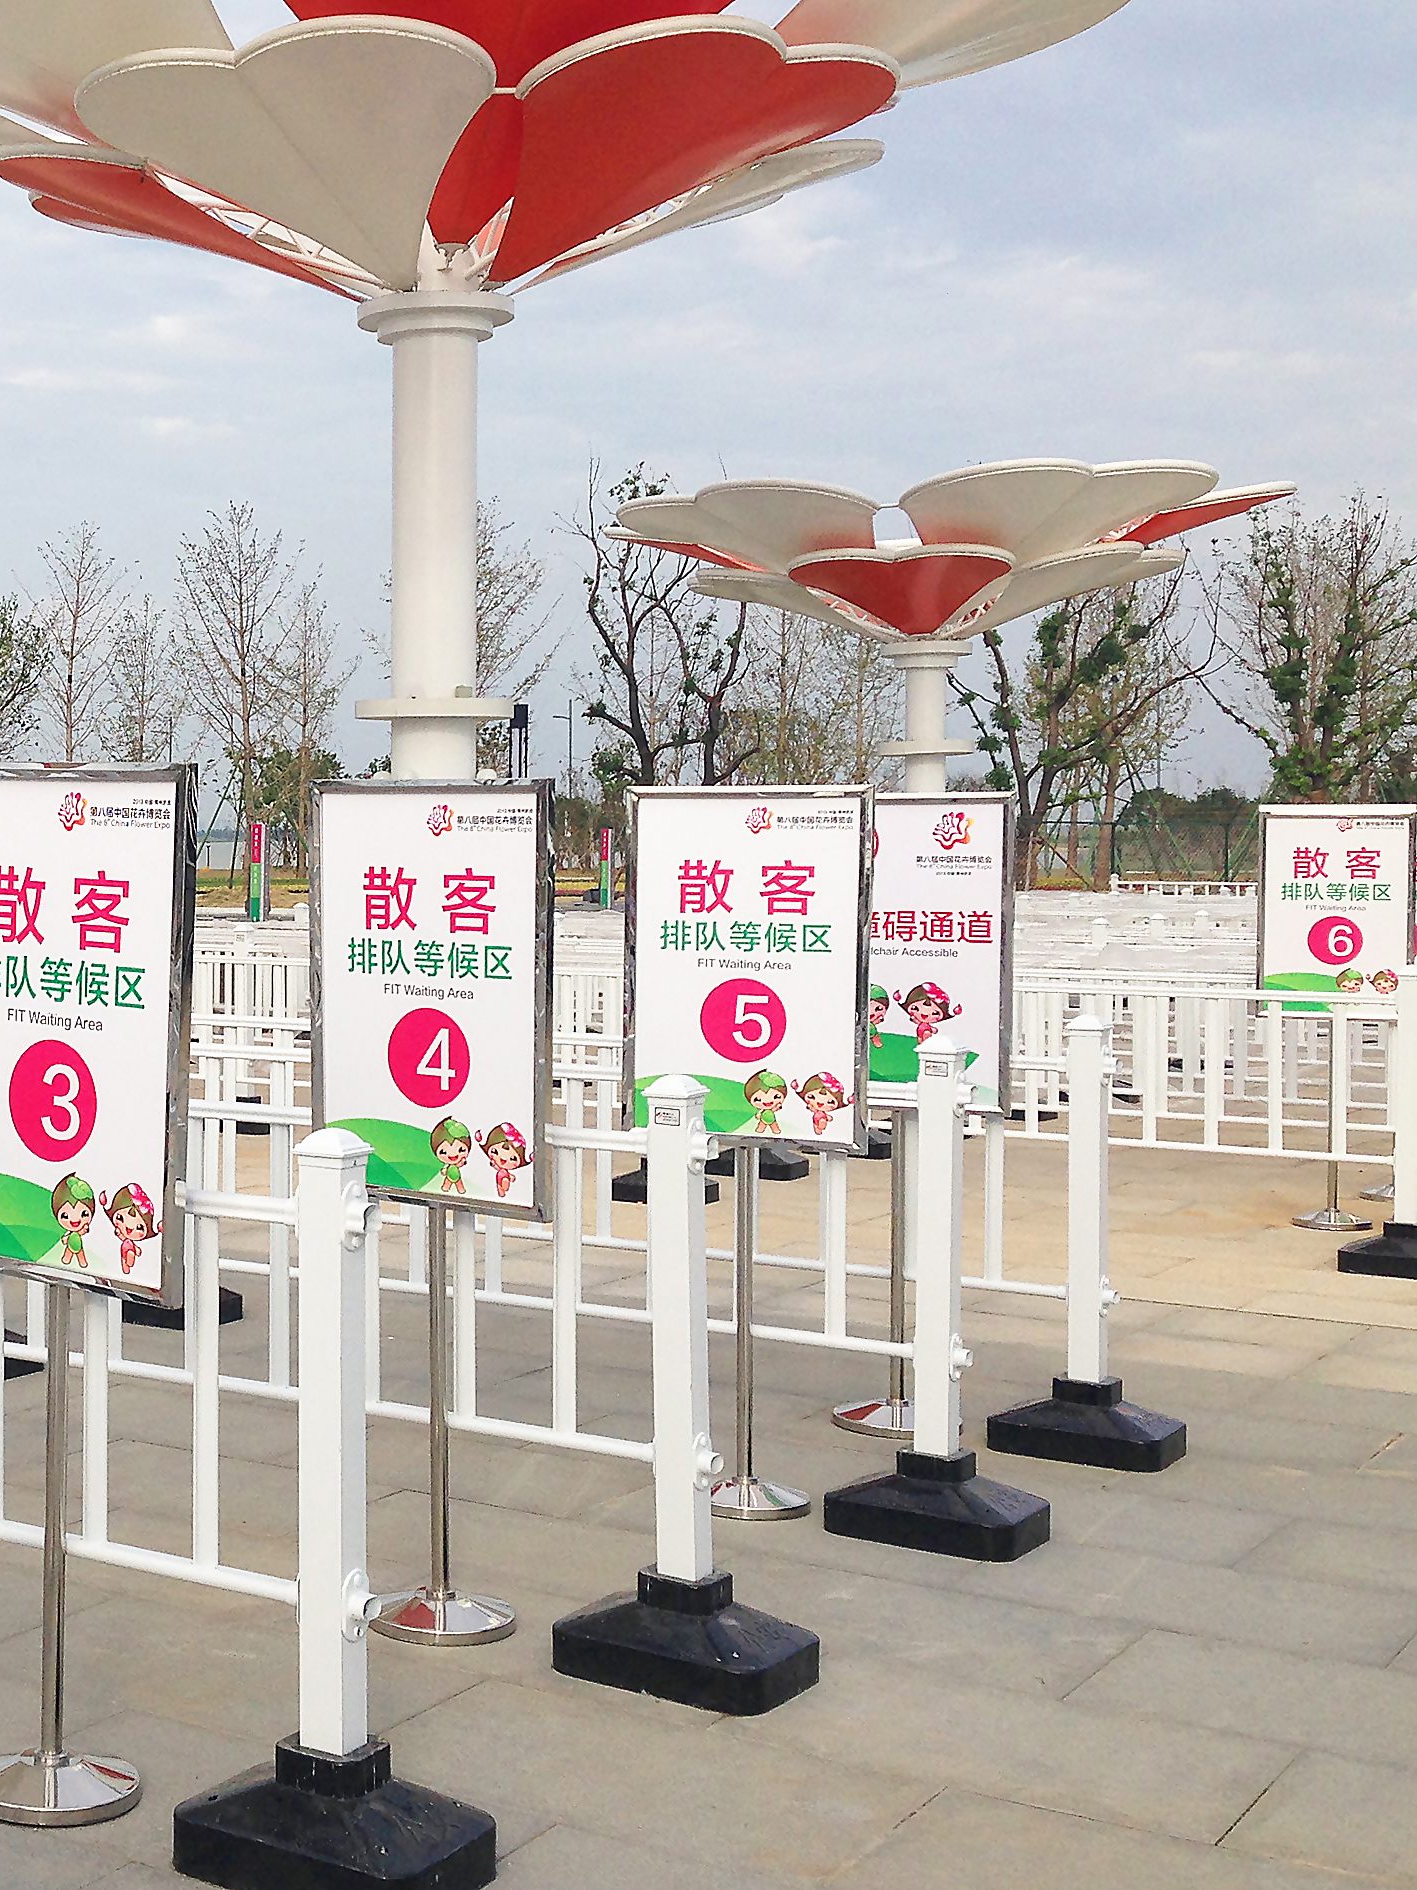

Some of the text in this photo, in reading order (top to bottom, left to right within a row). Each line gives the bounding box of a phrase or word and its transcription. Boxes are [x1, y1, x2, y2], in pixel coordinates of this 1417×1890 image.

[90, 807, 170, 819] 第八届中国花卉博览会
[1293, 847, 1381, 879] 散客
[362, 866, 496, 934] 散客
[677, 859, 815, 916] 散客
[1281, 882, 1392, 901] 排队等候区
[660, 920, 832, 953] 排队等候区
[871, 946, 958, 957] lchair Accessible
[1327, 925, 1355, 957] 6
[348, 936, 513, 980] 排队等候区
[697, 958, 792, 971] FIT Waiting Area
[384, 983, 474, 1000] FIT Waiting Area
[7, 1008, 103, 1031] FIT Waiting Area
[732, 995, 771, 1048] 5
[416, 1027, 457, 1091] 4
[40, 1063, 80, 1141] 3
